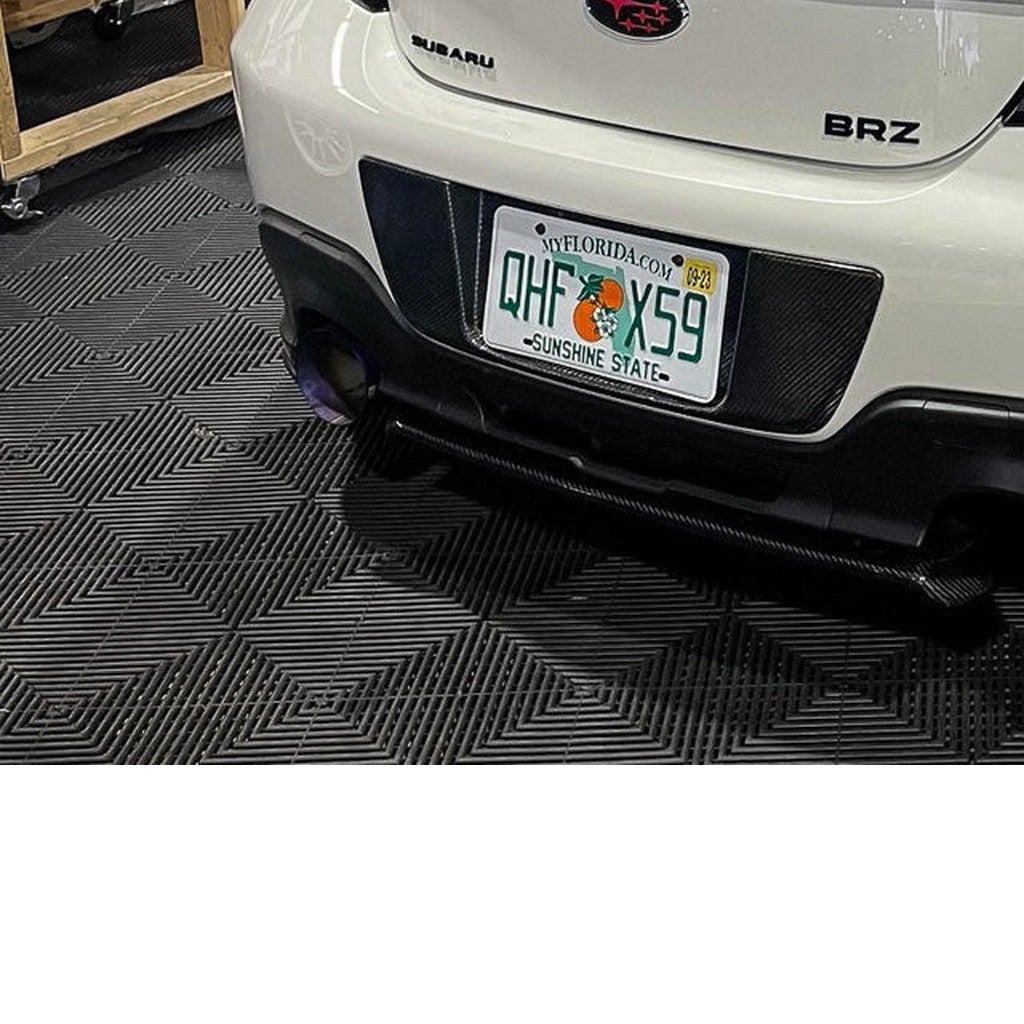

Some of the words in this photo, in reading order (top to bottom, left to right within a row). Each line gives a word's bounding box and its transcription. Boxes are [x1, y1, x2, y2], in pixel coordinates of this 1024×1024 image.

[411, 34, 494, 69] SUBARU
[824, 112, 920, 145] BRZ
[542, 234, 673, 282] MYFLORIDA.COM
[686, 265, 711, 290] 09-23
[499, 249, 576, 328] QHF
[623, 279, 708, 364] X59
[532, 333, 605, 369] SUNSHINE
[611, 352, 660, 382] STATE
